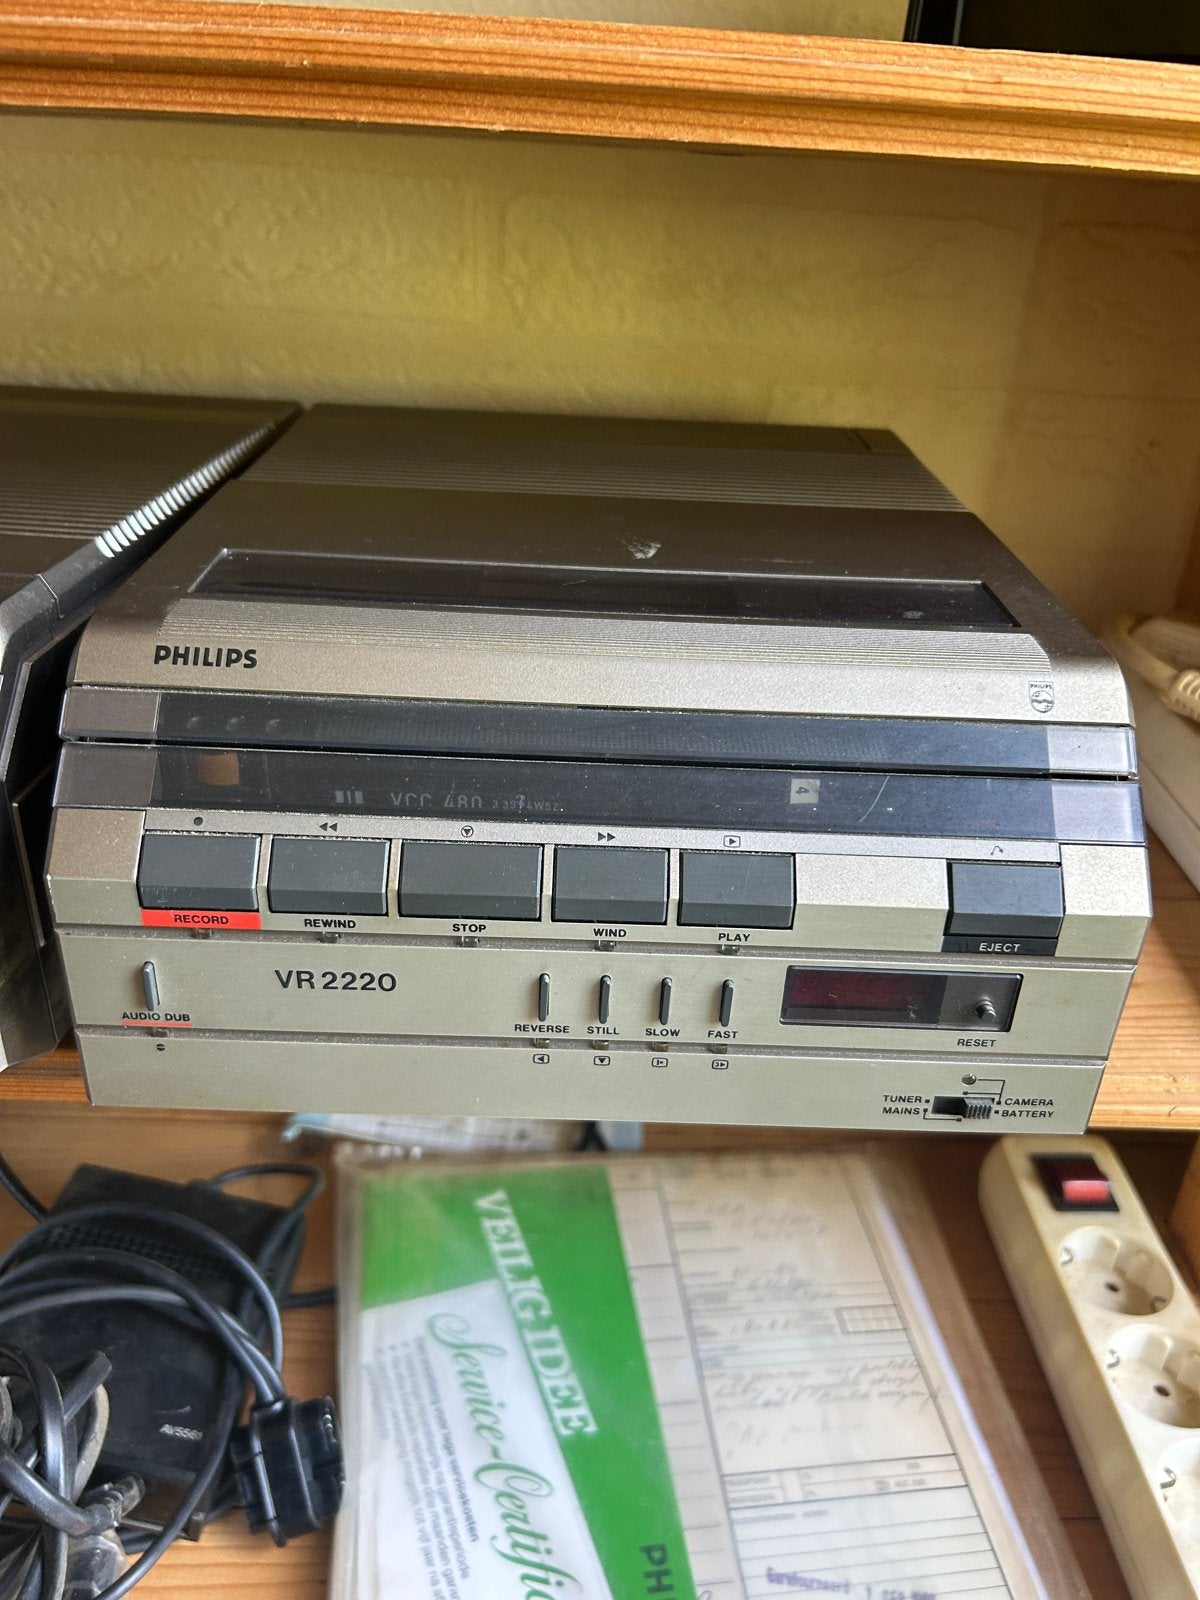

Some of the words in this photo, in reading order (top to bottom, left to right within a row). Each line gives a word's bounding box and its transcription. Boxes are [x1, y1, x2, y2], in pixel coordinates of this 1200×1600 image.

[154, 645, 258, 669] PHILIPS
[173, 913, 230, 926] RECORD
[303, 917, 357, 930] REWIND
[452, 922, 488, 934] STOP
[593, 926, 627, 939] WIND
[717, 931, 752, 944] PLAY
[978, 942, 1022, 953] EJECT
[274, 969, 316, 991] VR
[321, 970, 398, 993] 2220
[121, 1011, 161, 1023] AUDIO
[164, 1012, 191, 1023] DUB
[513, 1022, 571, 1035] REVERSE
[586, 1024, 621, 1037] STILL
[645, 1026, 682, 1039] SLOW
[707, 1029, 739, 1041] FAST
[957, 1037, 997, 1049] RESET
[882, 1094, 923, 1105] TUNER
[1004, 1097, 1055, 1108] CAMERA
[882, 1106, 920, 1117] MAINS
[1001, 1109, 1055, 1120] BATTERY
[474, 1188, 553, 1322] VEILIG
[523, 1323, 599, 1436] IDEE
[639, 1543, 676, 1600] PH
